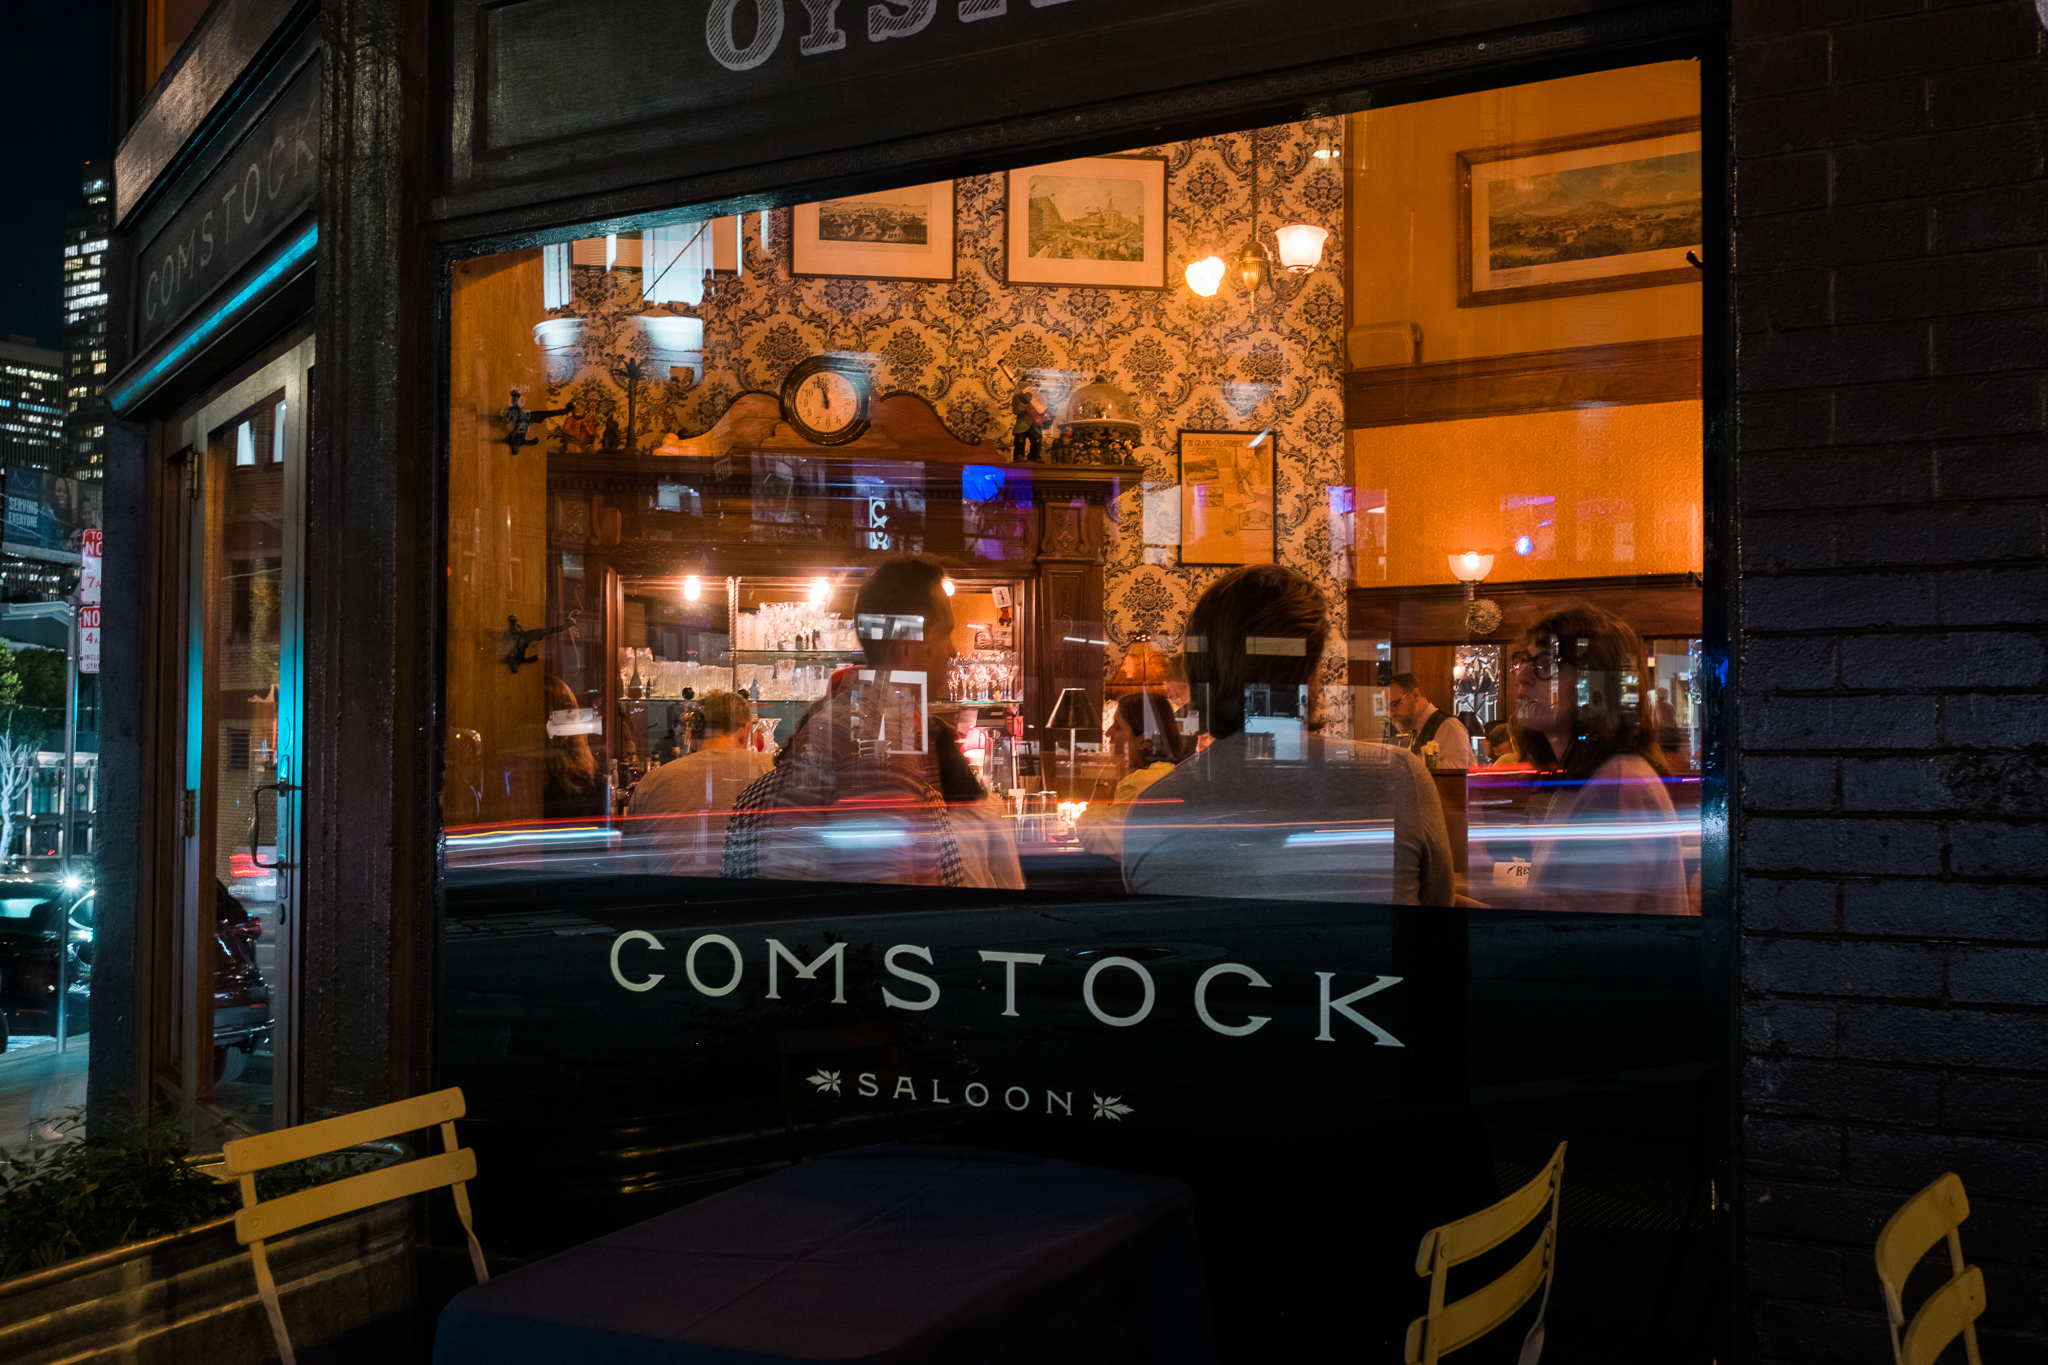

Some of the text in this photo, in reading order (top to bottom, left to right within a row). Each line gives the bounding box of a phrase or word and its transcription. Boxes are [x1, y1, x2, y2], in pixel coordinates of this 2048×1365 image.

[146, 99, 317, 321] COMSTOCK
[8, 511, 39, 528] EVERYONE
[9, 497, 39, 516] SERVING
[83, 610, 100, 626] NO
[610, 929, 1405, 1048] COMSTOCK
[858, 1072, 1074, 1116] SALOON
